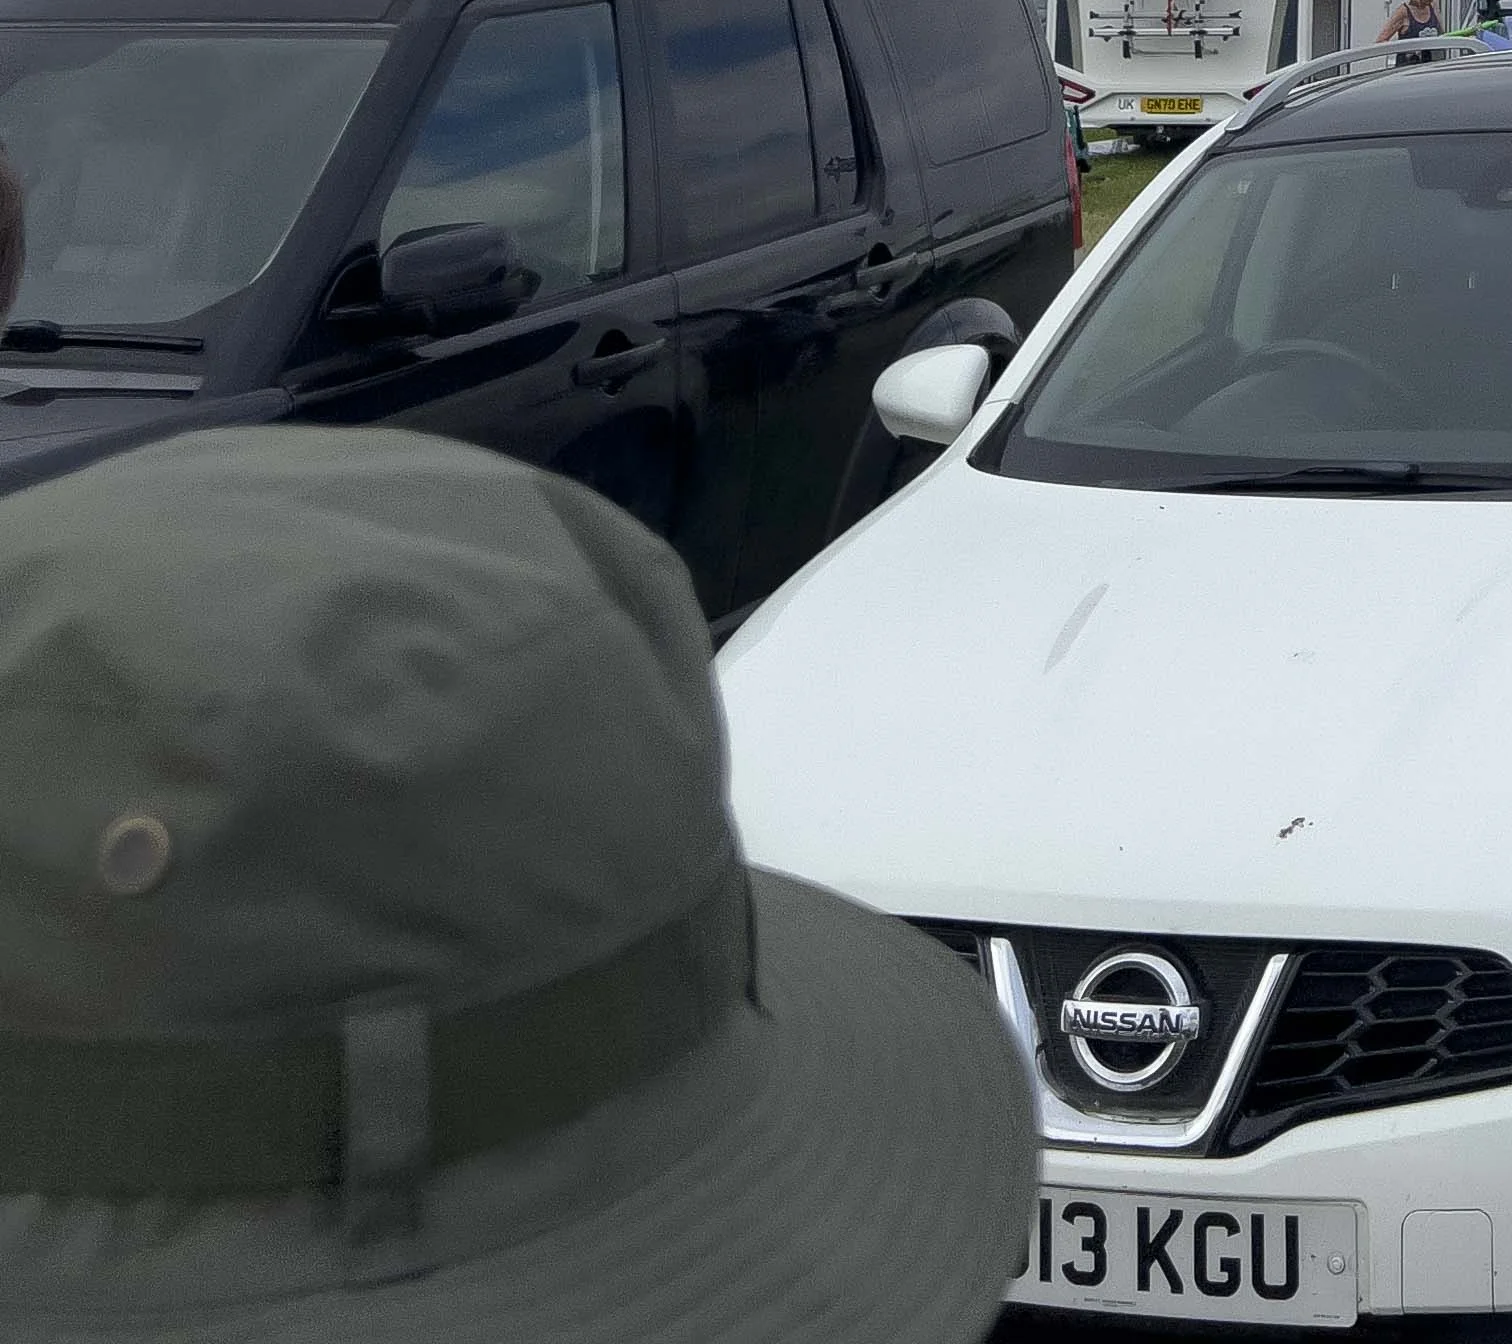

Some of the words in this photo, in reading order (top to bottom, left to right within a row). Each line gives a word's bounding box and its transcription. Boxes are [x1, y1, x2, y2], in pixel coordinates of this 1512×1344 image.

[1118, 98, 1134, 110] UK
[1072, 1008, 1183, 1034] NISSAN
[1014, 1198, 1107, 1287] 13
[1136, 1206, 1299, 1300] KGU
